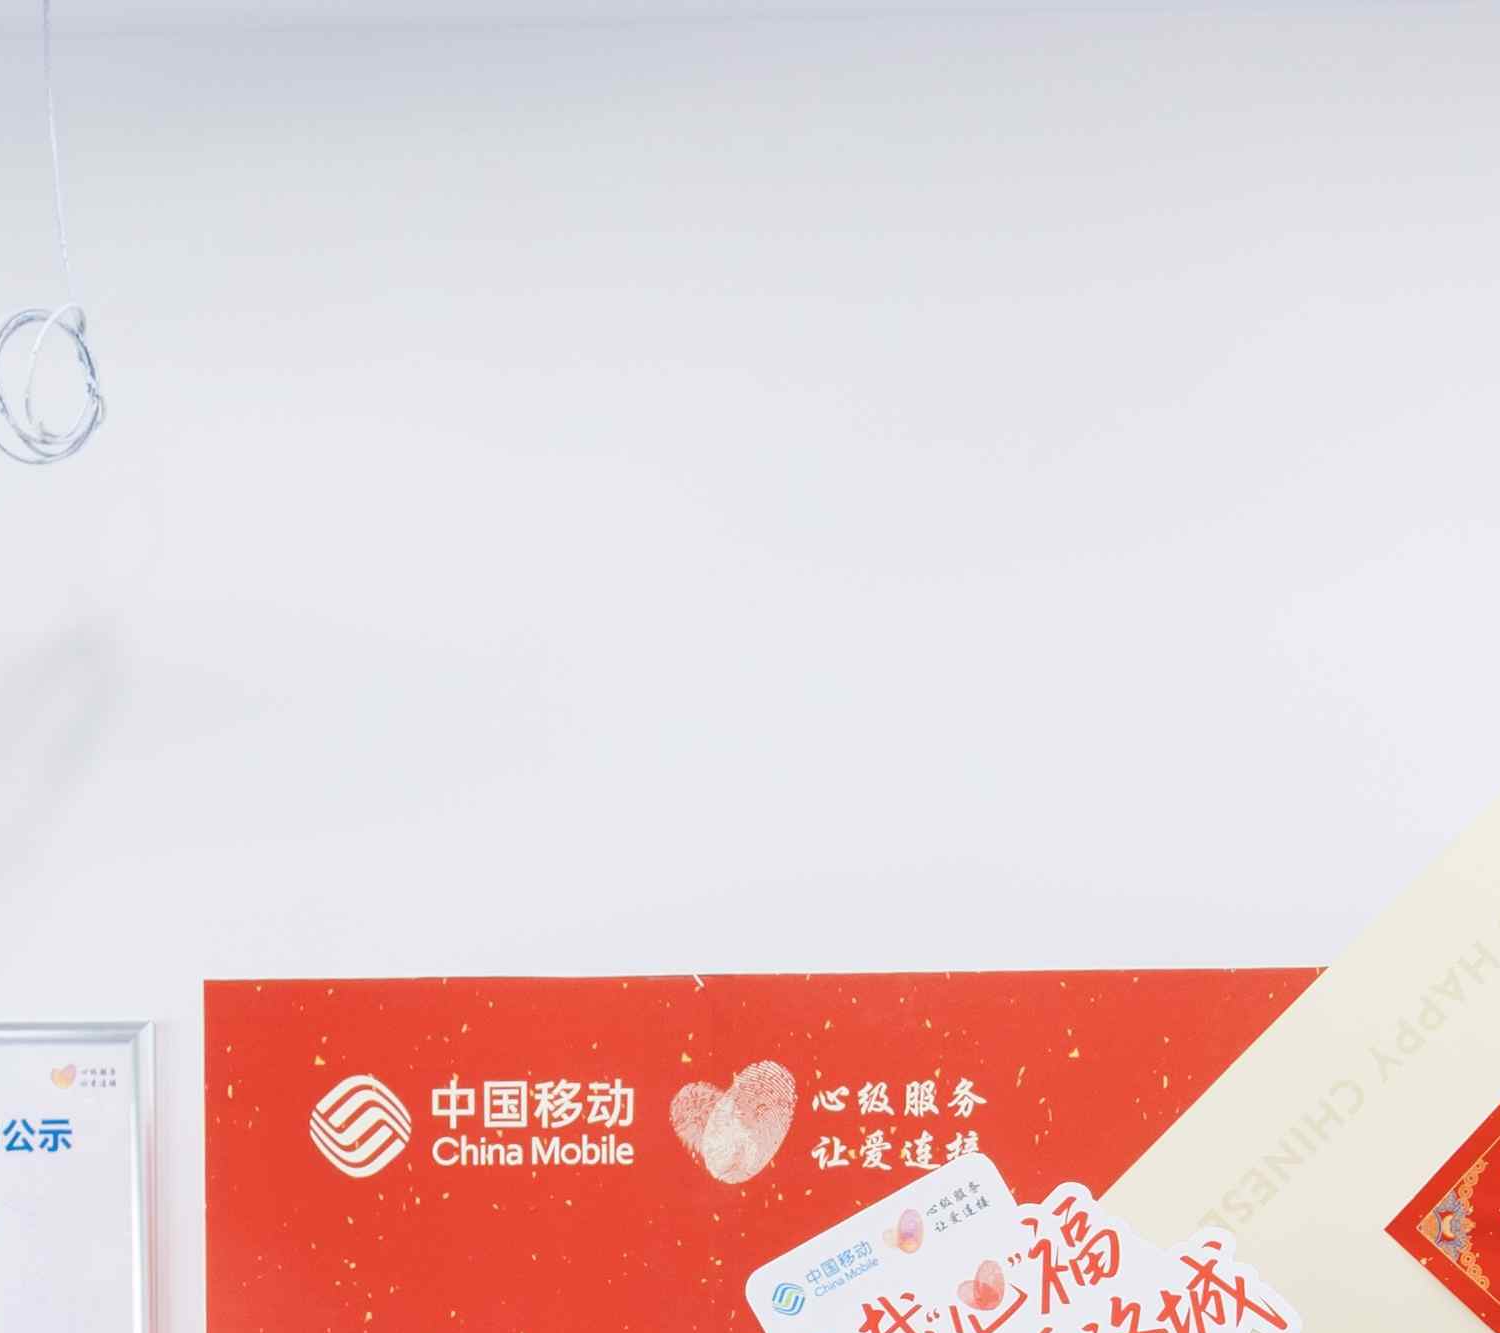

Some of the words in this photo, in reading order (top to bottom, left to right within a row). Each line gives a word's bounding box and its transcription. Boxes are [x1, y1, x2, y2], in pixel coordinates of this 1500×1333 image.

[1372, 941, 1500, 1085] HAPPY
[432, 1078, 636, 1130] 中国移动
[811, 1078, 988, 1120] 心级服务
[432, 1135, 524, 1167] China
[531, 1135, 635, 1167] Mobile
[805, 1240, 874, 1286] 中国移动
[814, 1277, 845, 1298] China
[845, 1256, 880, 1282] Mobile
